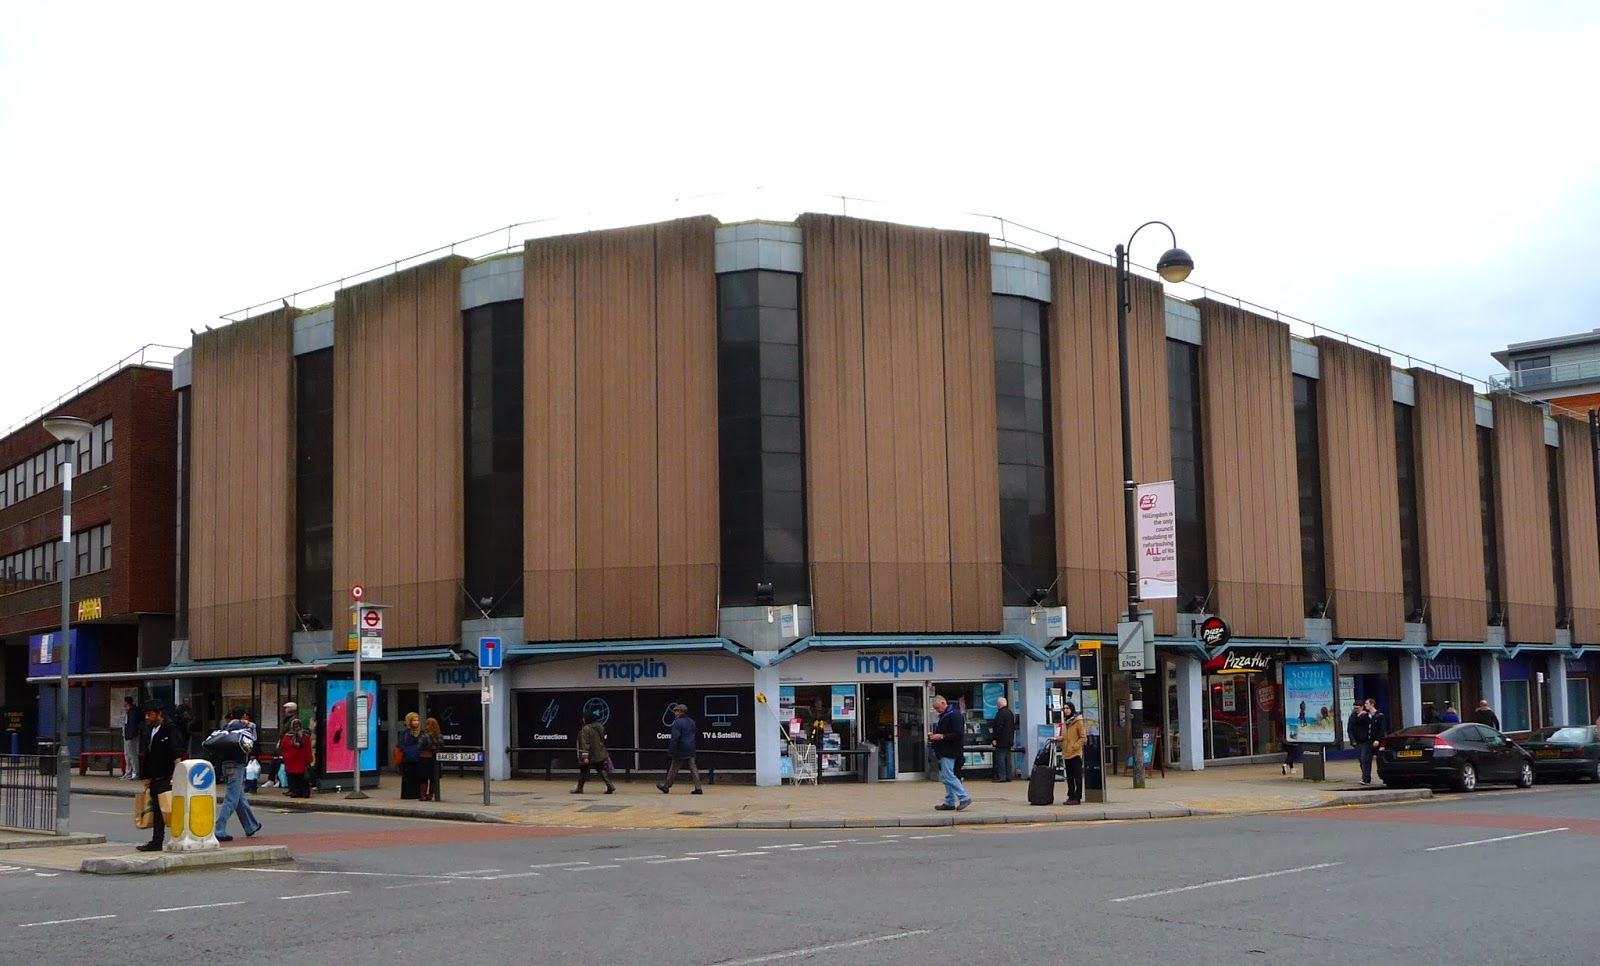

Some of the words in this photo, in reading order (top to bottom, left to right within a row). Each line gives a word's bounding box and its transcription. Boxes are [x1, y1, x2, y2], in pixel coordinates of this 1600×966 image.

[1146, 548, 1161, 556] ALL
[1203, 627, 1224, 639] Pizza
[1207, 633, 1222, 641] Hut
[856, 651, 934, 678] maplin
[1045, 652, 1077, 675] aplin
[1251, 652, 1272, 668] Hut
[598, 658, 667, 682] maplin
[1419, 656, 1462, 680] HSmith
[1292, 670, 1325, 679] SOPHIE
[1286, 678, 1332, 687] KINSELLA
[460, 753, 476, 761] ROAD
